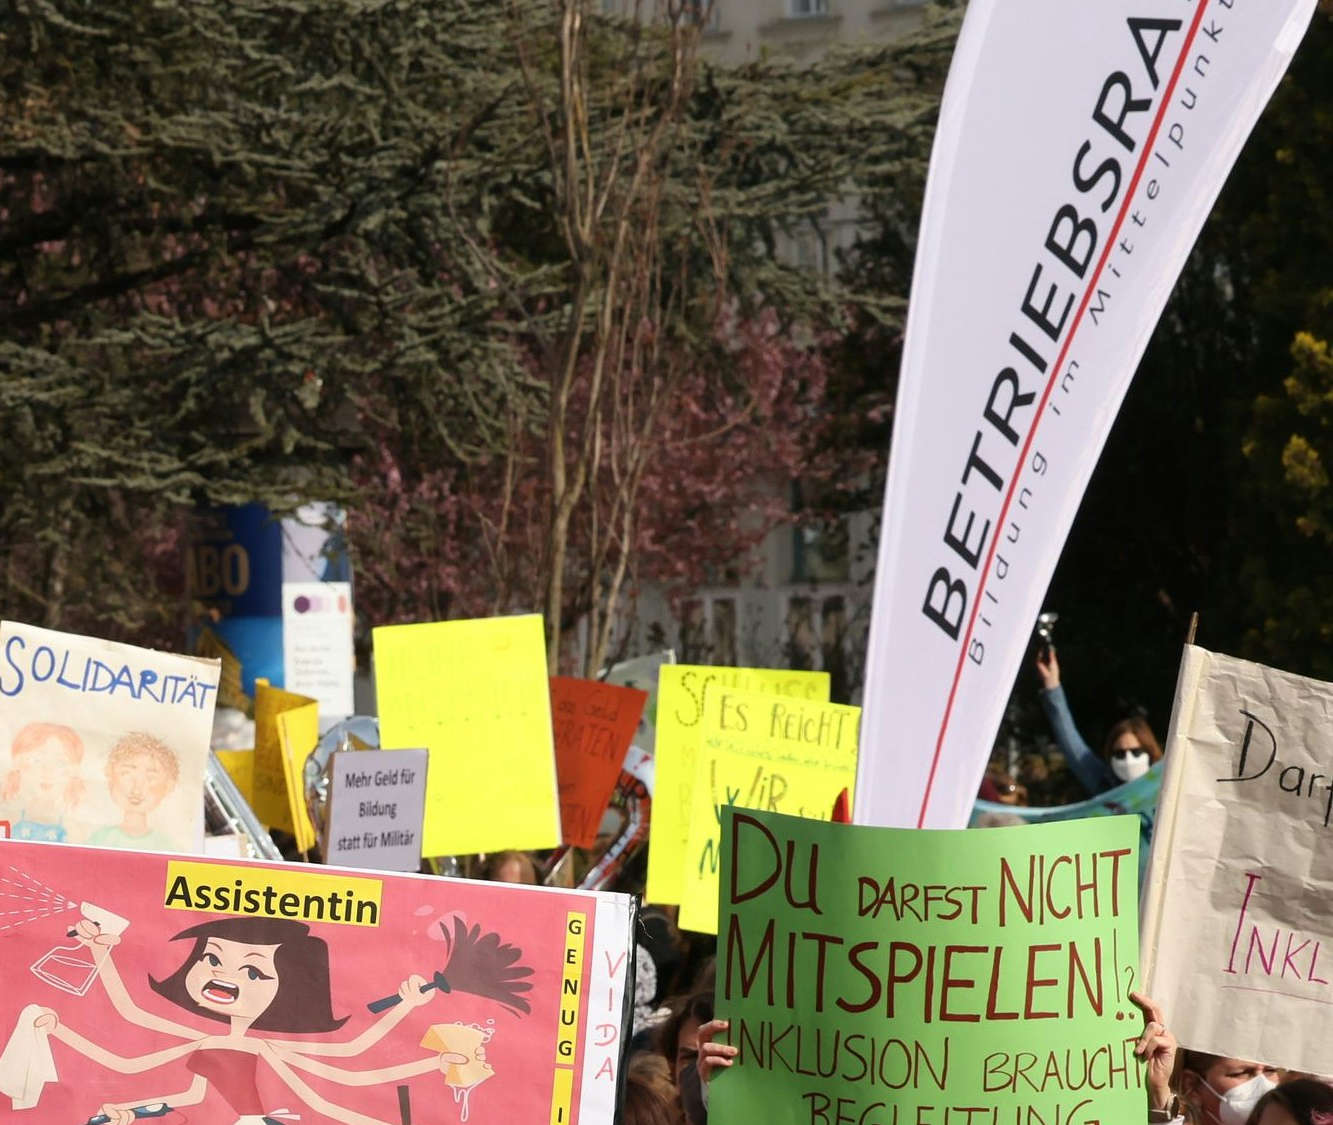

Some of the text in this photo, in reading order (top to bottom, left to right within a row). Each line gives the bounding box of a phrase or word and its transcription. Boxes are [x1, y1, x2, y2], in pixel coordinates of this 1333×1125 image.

[969, 451, 1049, 667] Bildung
[1049, 357, 1082, 418] im
[720, 694, 748, 732] ES
[345, 769, 416, 788] Mehr Geld für
[358, 801, 397, 819] Bildung
[337, 829, 414, 852] statt für Militär
[732, 813, 823, 915] DU
[858, 876, 987, 925] DARFST
[999, 848, 1131, 928] NICHT
[165, 874, 380, 926] Assistentin
[557, 918, 582, 1057] GENUG
[595, 950, 627, 1082] VIDA
[726, 1017, 1145, 1094] INKLUSION BRAUCHT
